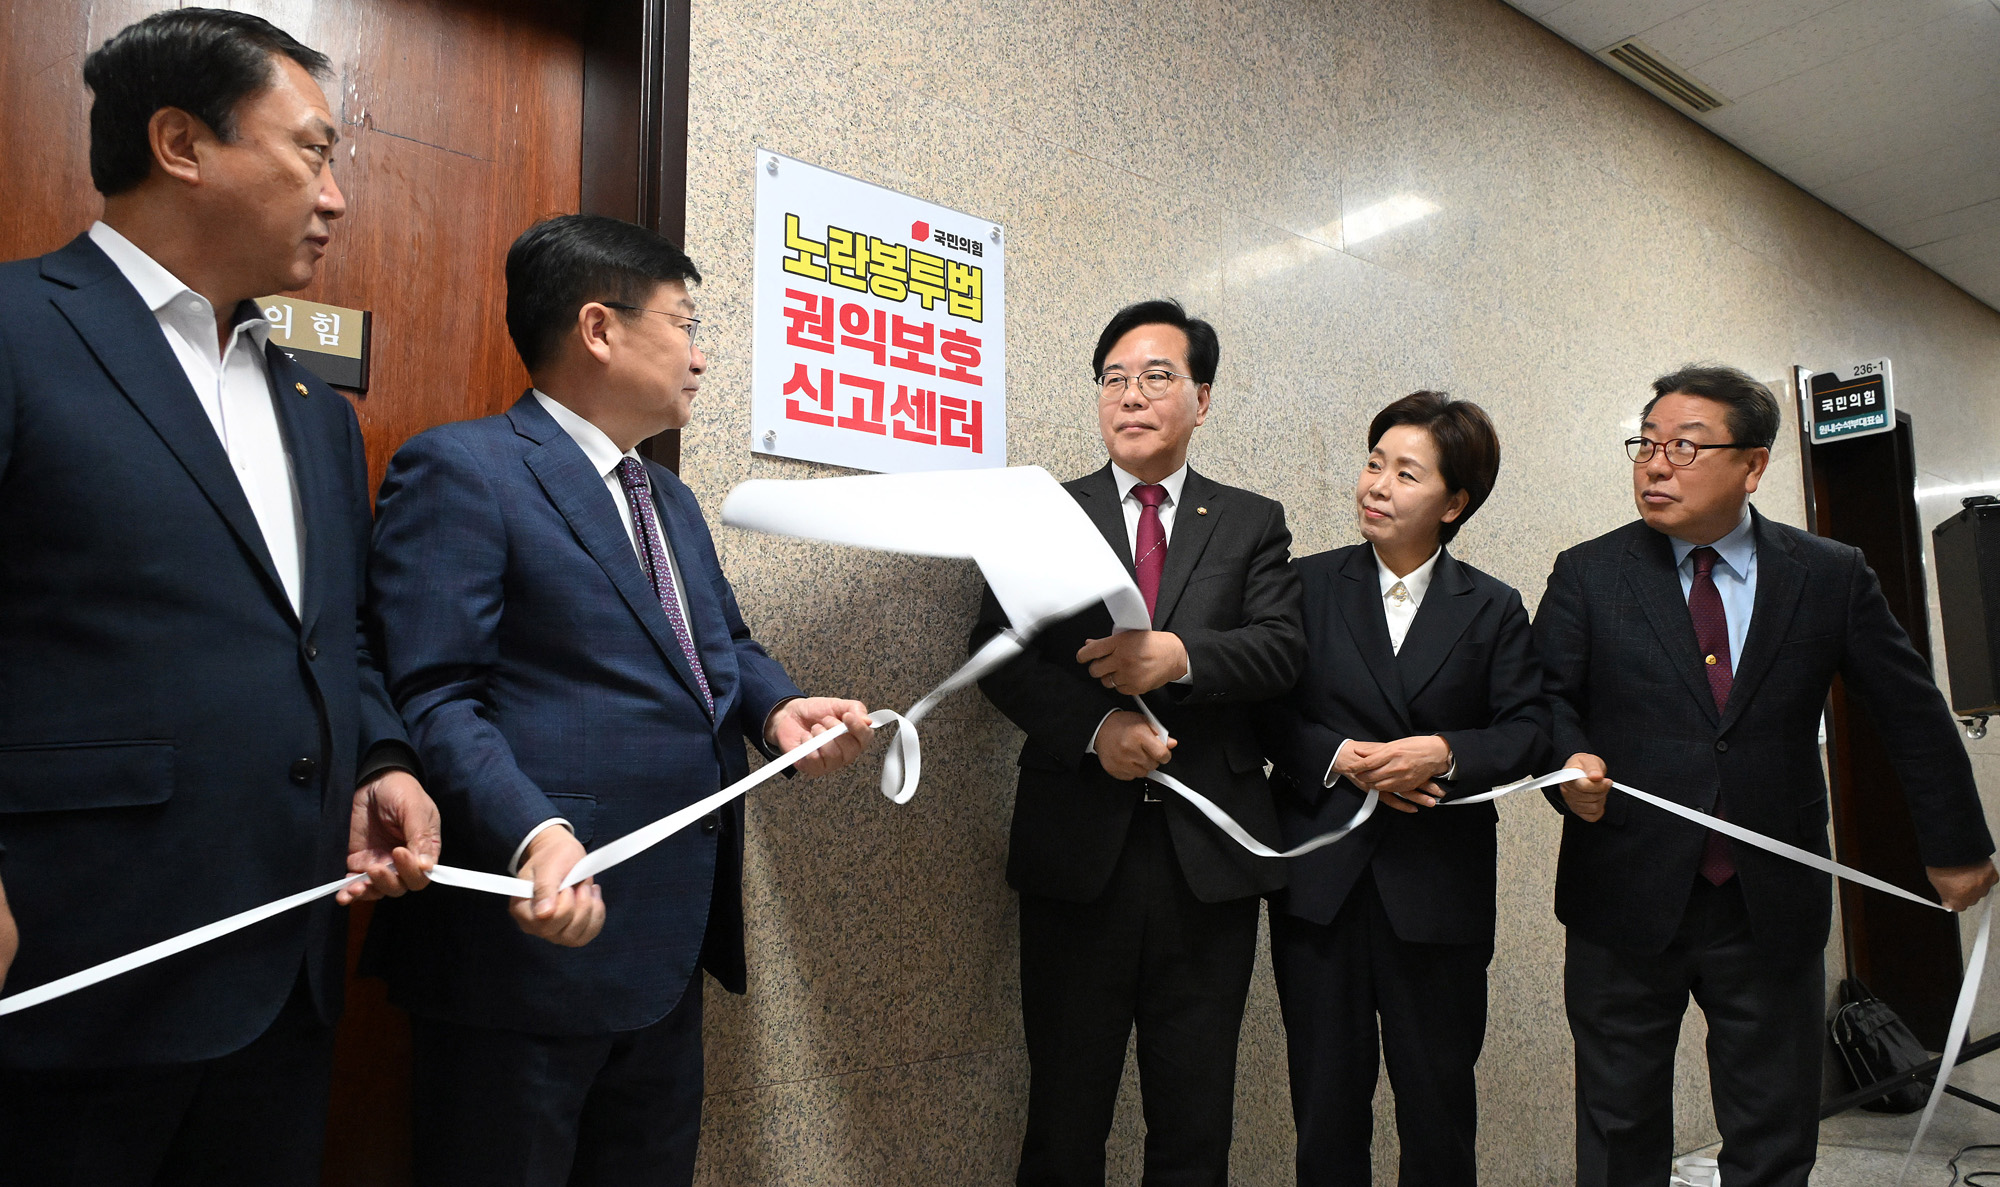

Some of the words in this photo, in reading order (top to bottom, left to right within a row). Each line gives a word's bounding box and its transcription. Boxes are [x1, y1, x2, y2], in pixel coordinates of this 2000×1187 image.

[934, 229, 983, 257] 국민의힘
[783, 212, 983, 323] 노란봉투법
[783, 287, 983, 387] 권익보호
[1853, 361, 1884, 376] 236-1
[783, 362, 983, 454] 신고센터
[1822, 390, 1876, 412] 국민의힘
[1819, 414, 1884, 435] 원내수석부대표실
